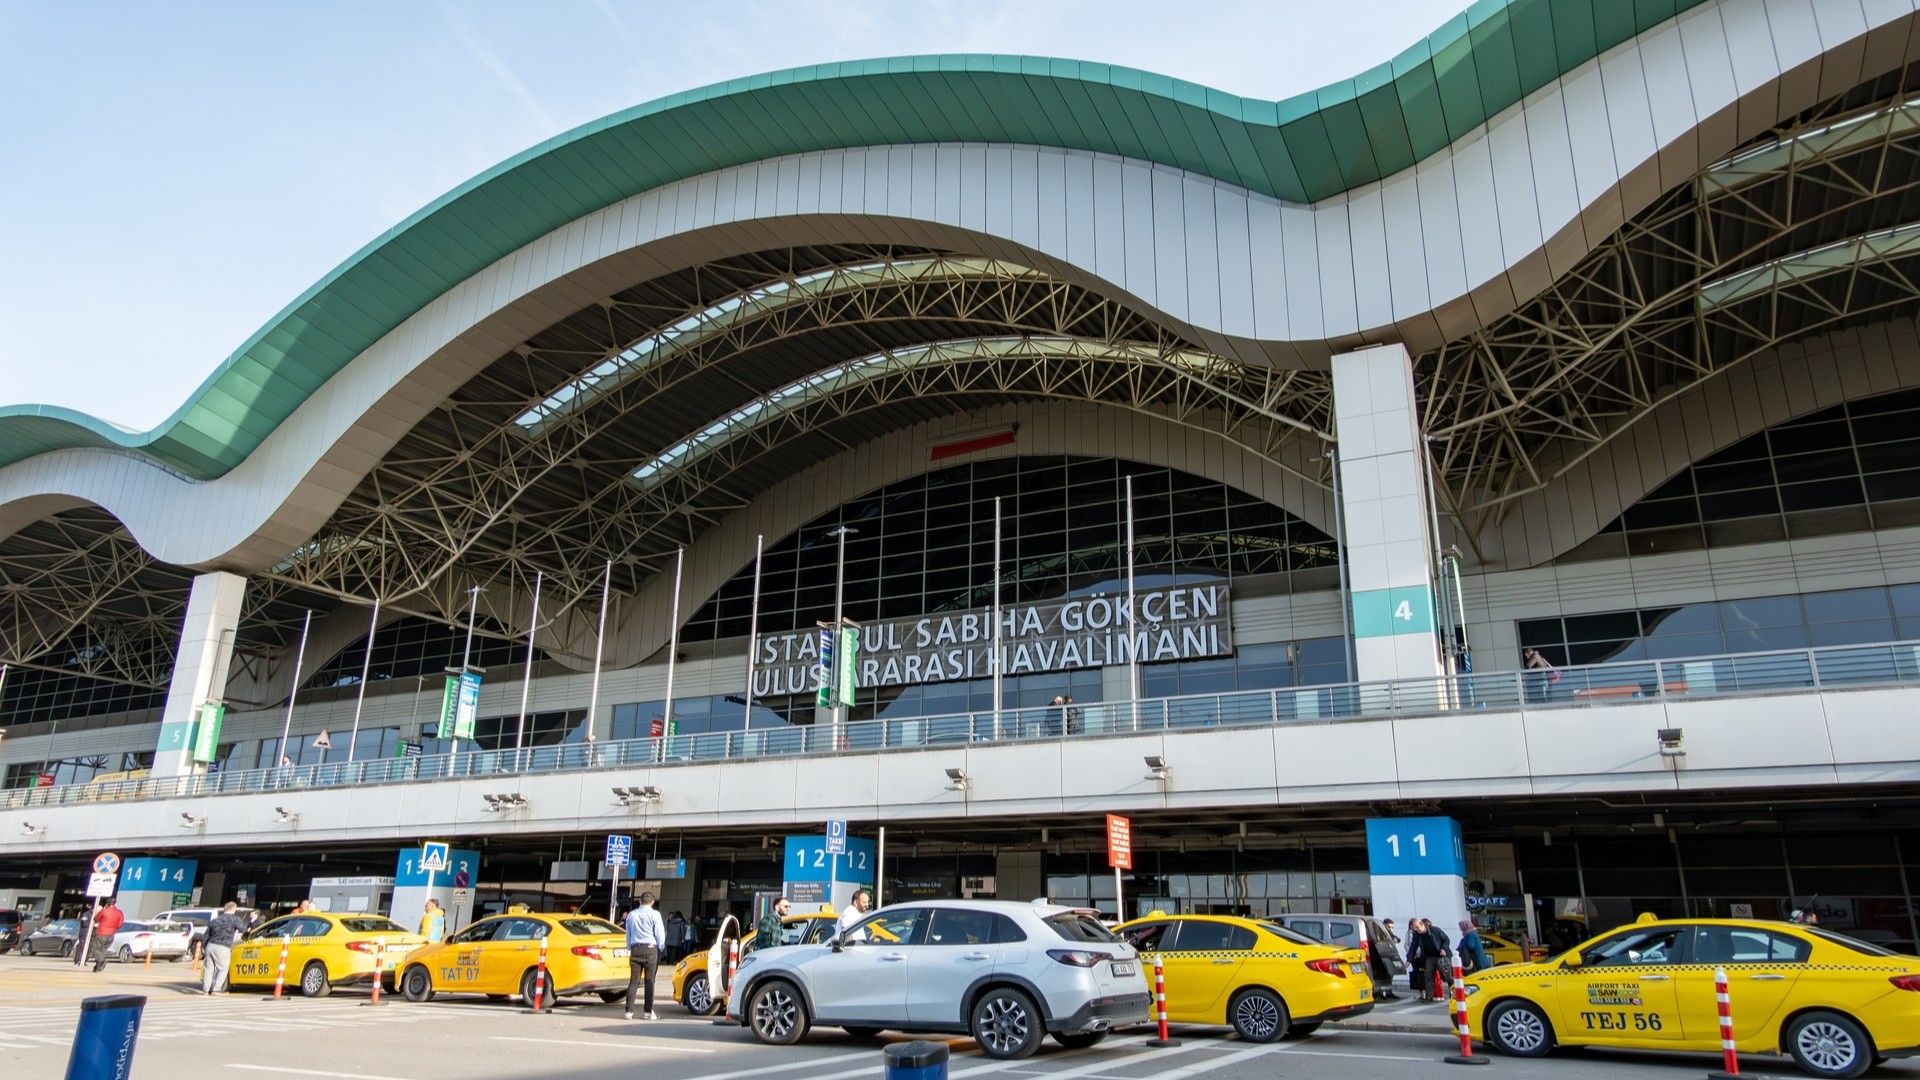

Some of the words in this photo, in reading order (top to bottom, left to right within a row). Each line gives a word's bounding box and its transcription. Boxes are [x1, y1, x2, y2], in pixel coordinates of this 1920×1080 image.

[1394, 600, 1413, 621] 4
[754, 623, 901, 664] İSTABUL
[916, 605, 1045, 648] SABİHA
[1060, 585, 1218, 632] GÖKÇEN
[752, 649, 974, 697] ULUSRARASI
[987, 624, 1219, 677] HAVALİMANI
[445, 680, 460, 738] ENUYGUN
[172, 729, 181, 743] 5
[832, 821, 841, 836] D
[1386, 833, 1427, 857] 11
[796, 849, 825, 868] 12
[847, 850, 866, 870] 12
[127, 867, 142, 880] 14
[160, 868, 184, 882] 14
[236, 964, 255, 975] TCM
[258, 963, 269, 974] 86
[441, 967, 462, 981] TAT
[466, 967, 480, 981] 07
[1580, 1012, 1626, 1030] TEJ
[1633, 1012, 1662, 1031] 56
